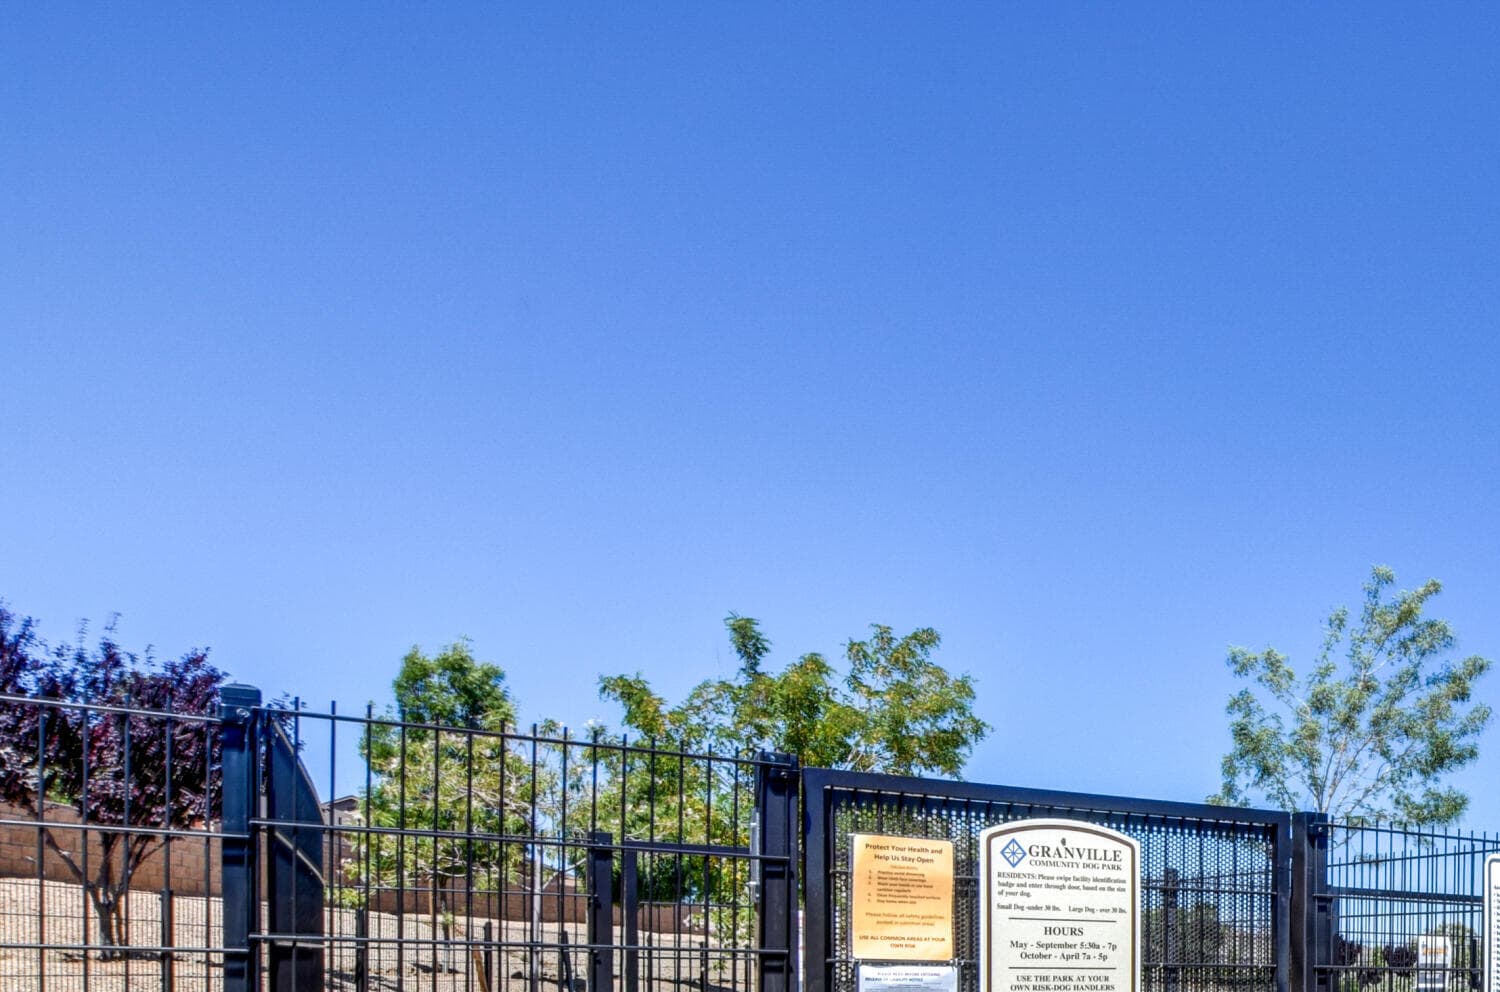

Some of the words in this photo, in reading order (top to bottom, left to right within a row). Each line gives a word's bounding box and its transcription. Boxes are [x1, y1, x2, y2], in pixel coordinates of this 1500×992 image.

[865, 843, 889, 851] Protect
[874, 854, 889, 862] Help
[1028, 844, 1122, 862] GRANVILLE
[1029, 860, 1080, 869] COMMUNITY
[1082, 862, 1100, 870] DOG
[1101, 863, 1122, 871] PARK
[998, 880, 1014, 888] badge
[1072, 876, 1091, 884] facility
[1092, 876, 1126, 884] identification
[998, 888, 1004, 896] of
[1020, 890, 1032, 898] dog.
[997, 902, 1012, 910] Small
[1014, 904, 1024, 912] Dog
[1068, 906, 1084, 914] Large
[1084, 906, 1095, 914] Dog
[1044, 926, 1084, 936] HOURS
[1010, 940, 1028, 949] May
[1036, 941, 1077, 950] September
[1079, 942, 1100, 950] 5:30a
[1108, 942, 1117, 951] 7p
[1020, 952, 1052, 960] October
[1060, 952, 1080, 961] April
[1097, 953, 1108, 962] 5p
